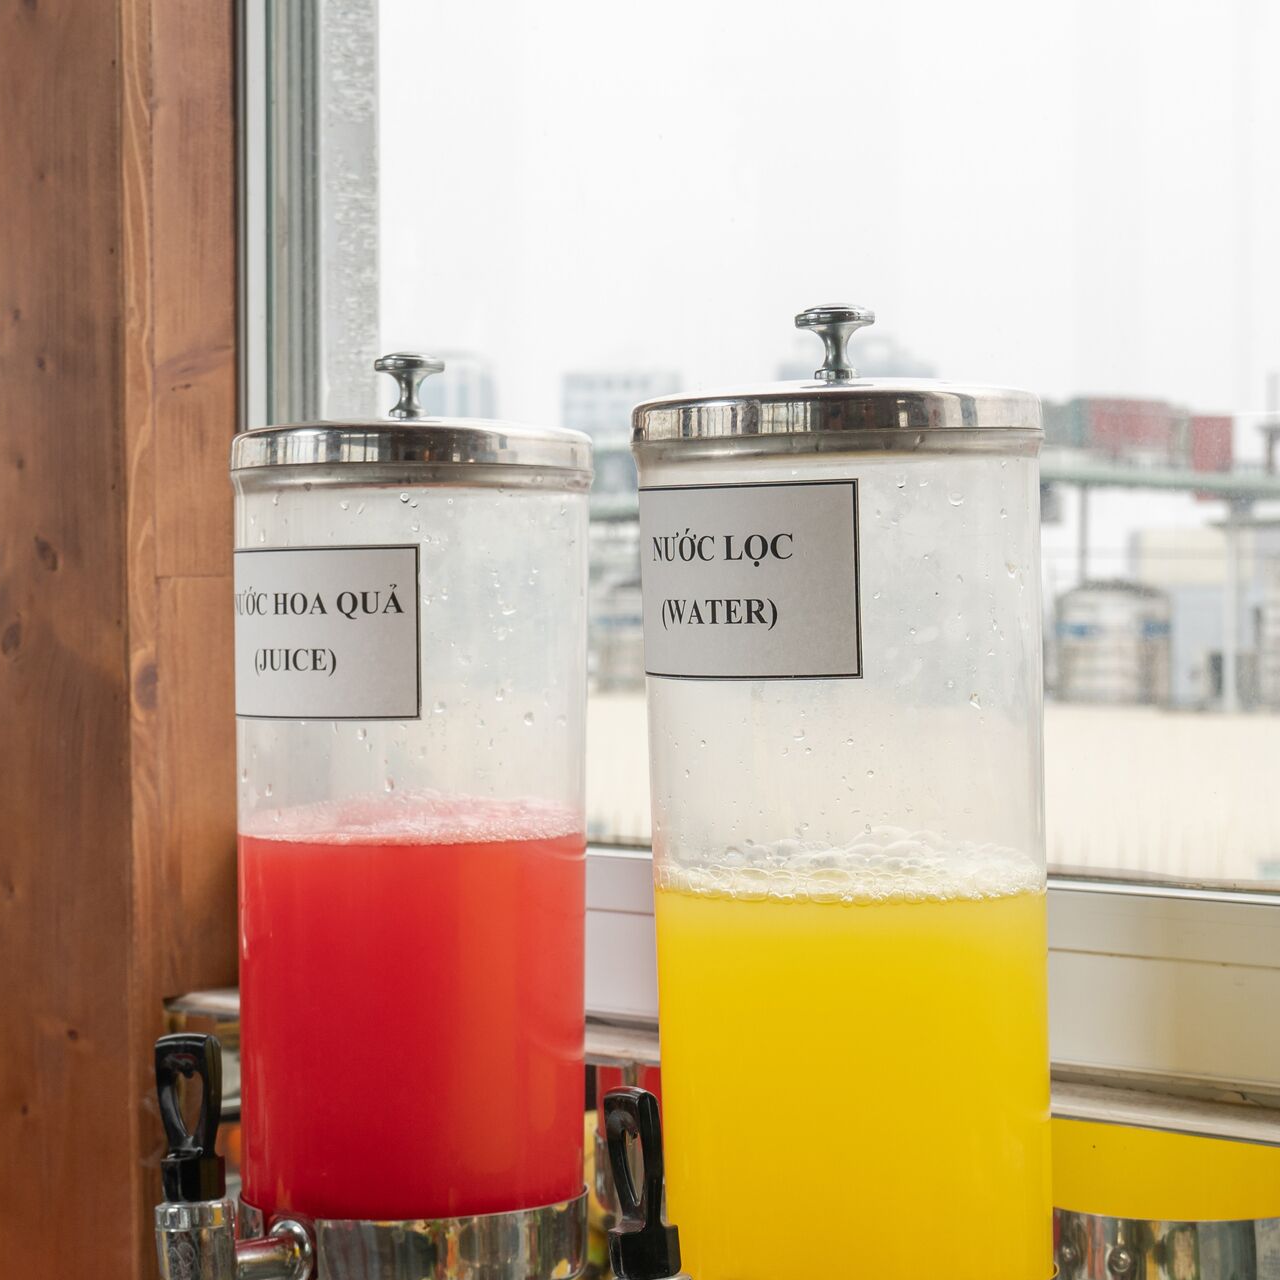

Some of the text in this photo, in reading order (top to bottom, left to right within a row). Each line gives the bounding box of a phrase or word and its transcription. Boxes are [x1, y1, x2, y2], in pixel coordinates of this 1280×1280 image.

[652, 529, 794, 567] NƯỚC LỌC
[273, 592, 328, 615] HOA
[336, 583, 404, 620] QUẢ
[661, 597, 778, 632] (WATER)
[254, 648, 337, 677] (JUICE)
